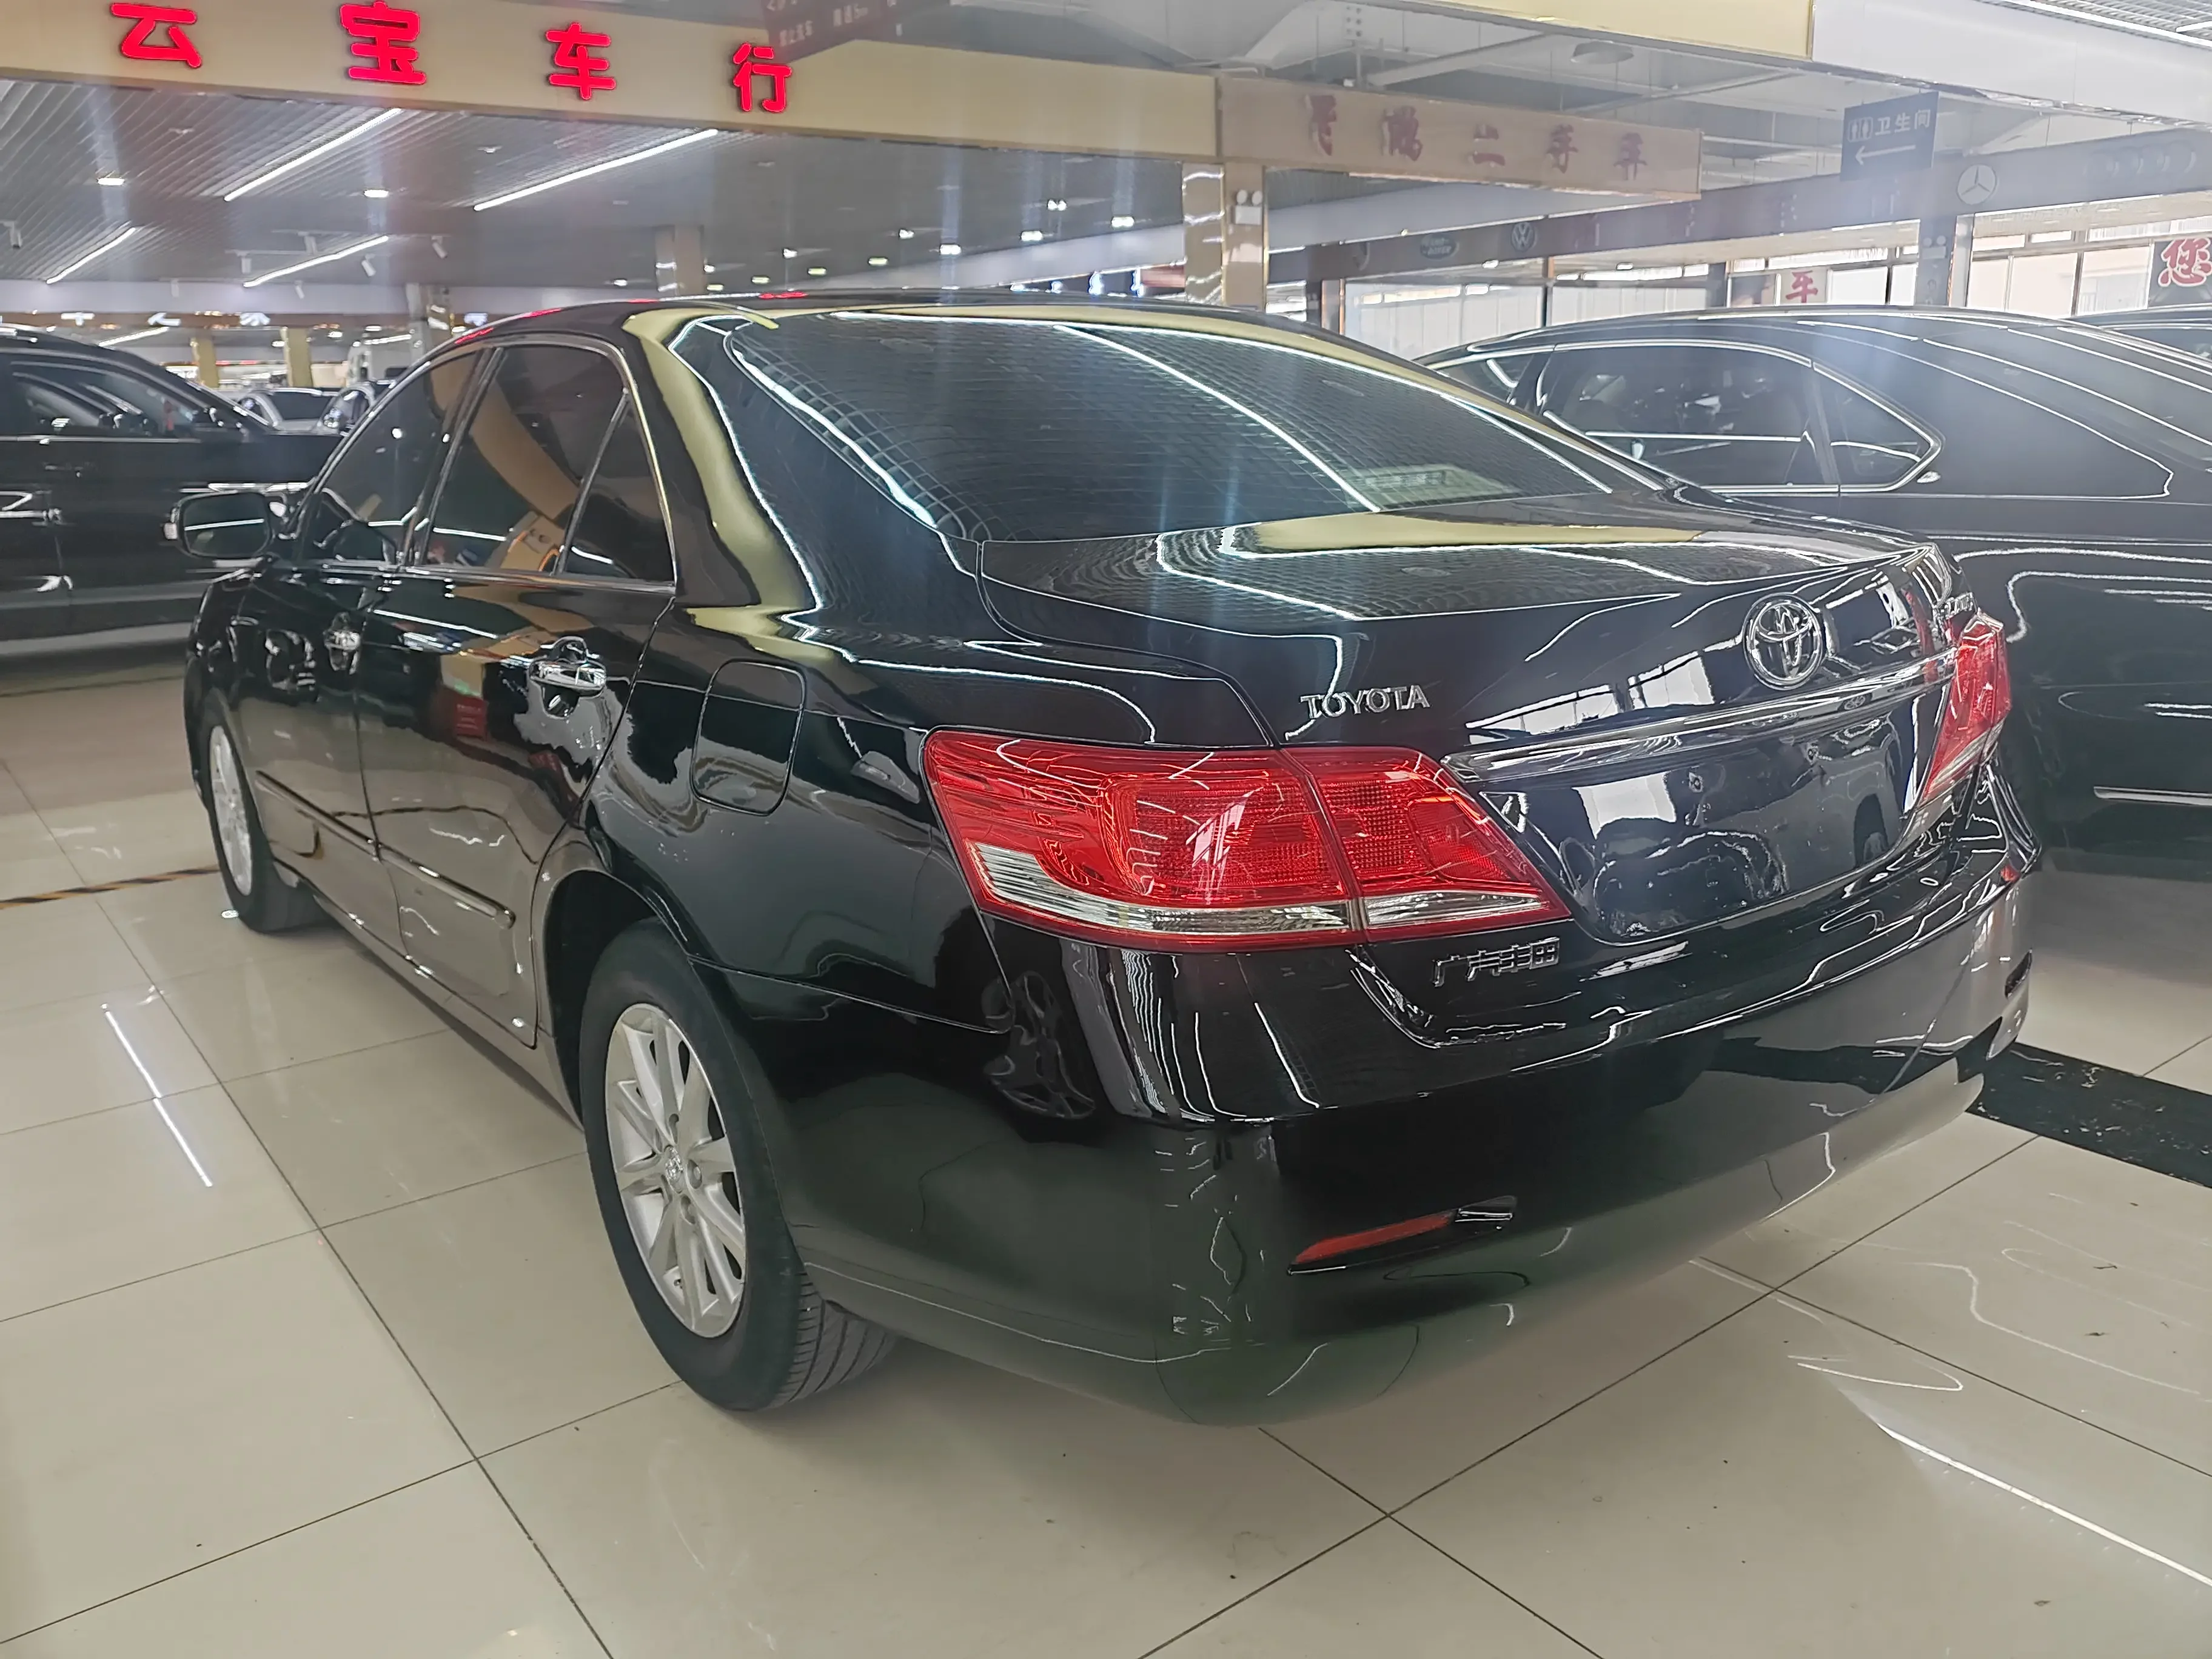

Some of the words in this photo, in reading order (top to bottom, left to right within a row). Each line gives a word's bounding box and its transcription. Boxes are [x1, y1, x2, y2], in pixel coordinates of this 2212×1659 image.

[110, 1, 792, 113] 云宝车行
[1875, 109, 1931, 136] 卫生间
[2157, 238, 2212, 287] 您
[1299, 685, 1430, 718] TOYOTA
[1434, 937, 1560, 987] 广汽丰田
